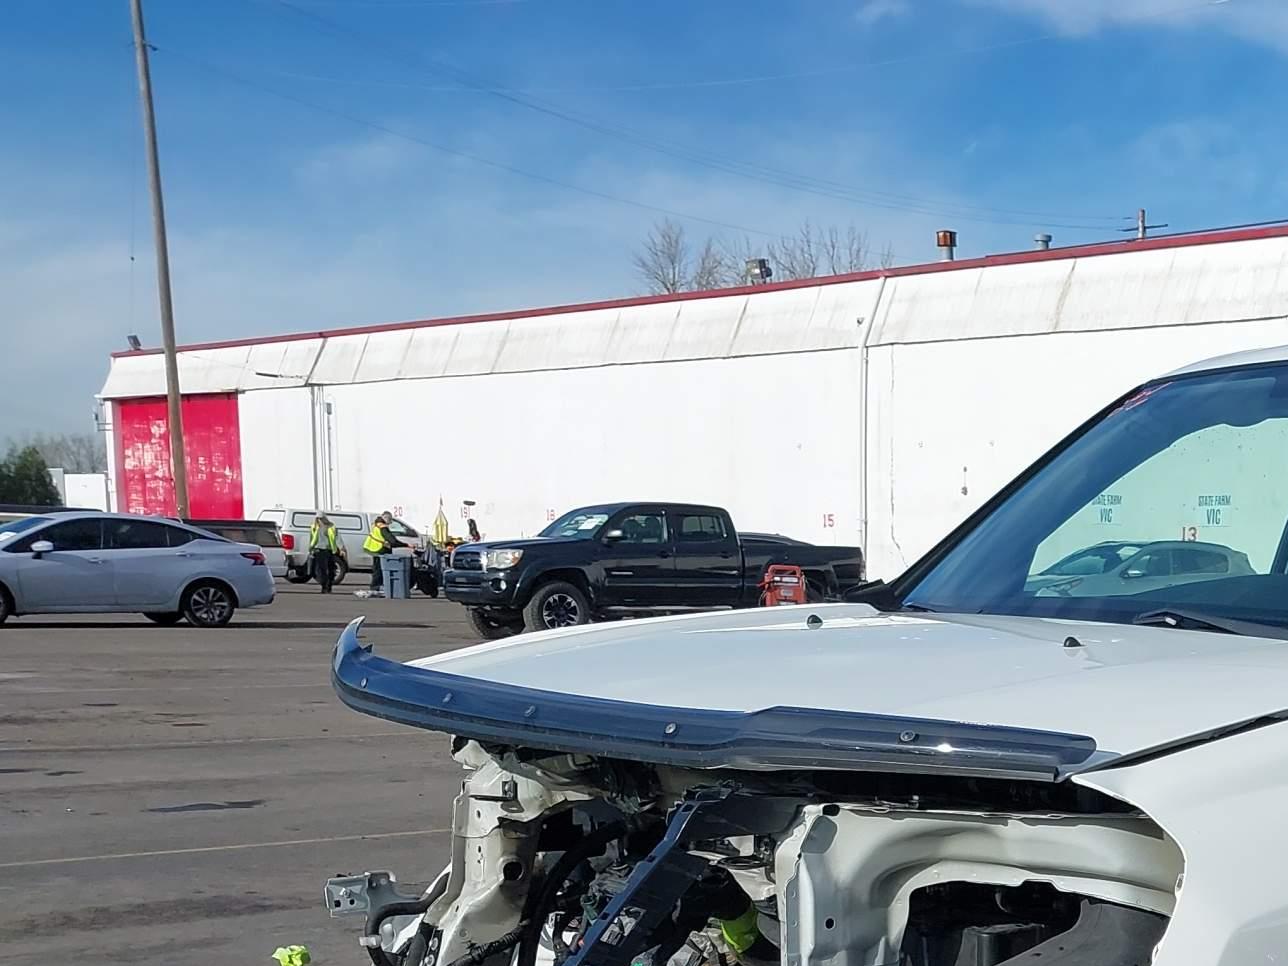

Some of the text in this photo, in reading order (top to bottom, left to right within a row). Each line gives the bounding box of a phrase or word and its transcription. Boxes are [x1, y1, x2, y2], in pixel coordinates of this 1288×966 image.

[1198, 494, 1231, 507] STATE FARM
[393, 506, 403, 518] 20
[1206, 508, 1221, 525] VIC
[823, 513, 835, 528] 15
[1182, 526, 1197, 542] 13
